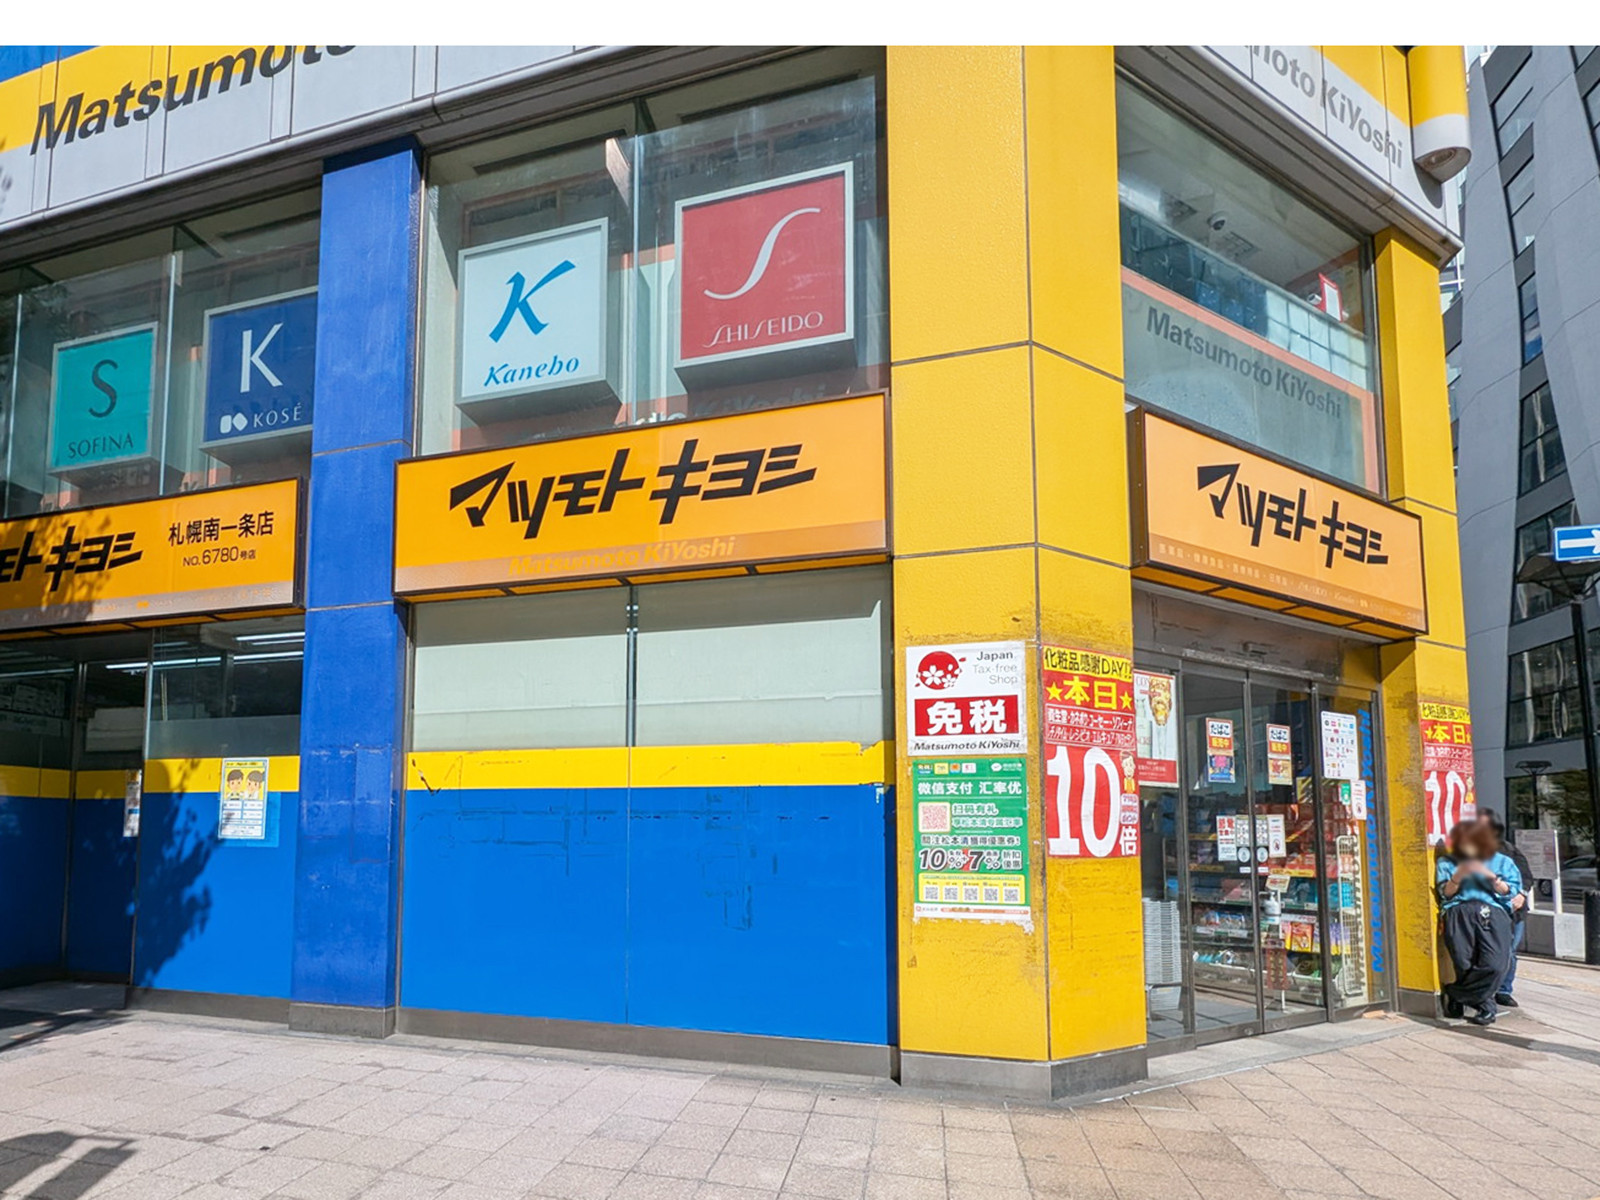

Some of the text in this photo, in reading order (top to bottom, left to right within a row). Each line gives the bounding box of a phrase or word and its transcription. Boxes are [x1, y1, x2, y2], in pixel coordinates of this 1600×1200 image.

[30, 45, 356, 155] Matsumo
[1320, 78, 1403, 168] KiYoshi
[489, 259, 576, 343] K
[702, 311, 824, 348] SHISEIDO
[240, 322, 283, 393] K
[484, 354, 580, 387] Kanebo
[1146, 306, 1342, 419] Matsumoto KiYoshi
[88, 359, 119, 418] S
[253, 402, 303, 428] KOSÉ
[68, 432, 134, 459] SOFINA
[449, 438, 818, 540] マツモトキヨシ
[168, 510, 274, 547] 札幌南一条店
[1196, 463, 1389, 569] マツモトキヨシ
[508, 536, 736, 576] Matsumoto KiYoshi
[976, 651, 1014, 662] Japan
[988, 674, 1018, 686] Shop
[1063, 676, 1117, 709] 本日
[926, 699, 1008, 735] 免税
[914, 740, 1020, 752] Matsumoto KiYoshi
[918, 781, 973, 795] 微信支付
[1047, 746, 1121, 857] 10
[1119, 826, 1138, 855] 倍
